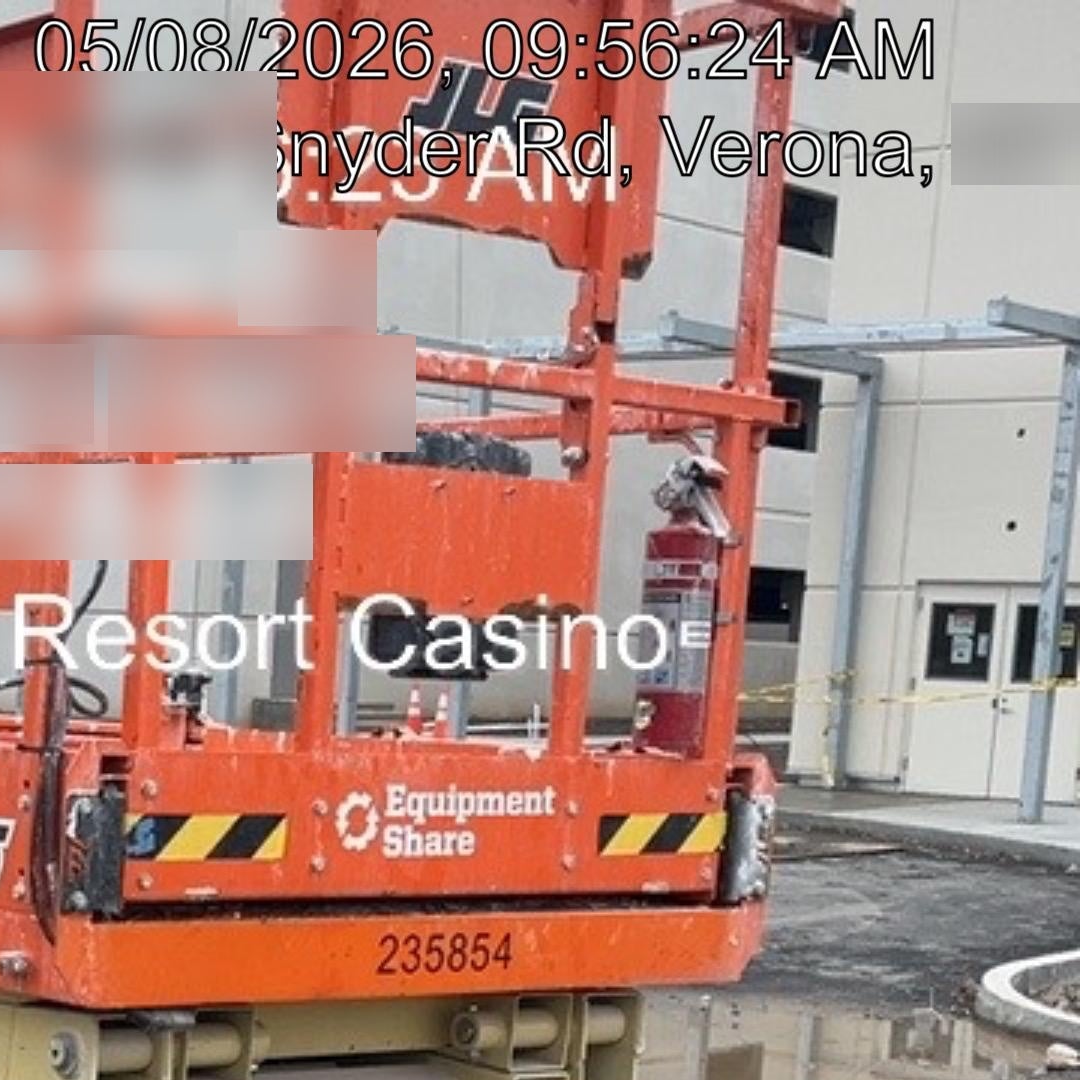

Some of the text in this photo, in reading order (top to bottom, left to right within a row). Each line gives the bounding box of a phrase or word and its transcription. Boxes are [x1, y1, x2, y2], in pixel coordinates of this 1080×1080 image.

[384, 783, 556, 824] Equipment
[382, 825, 476, 859] Share
[376, 931, 513, 975] 235854
